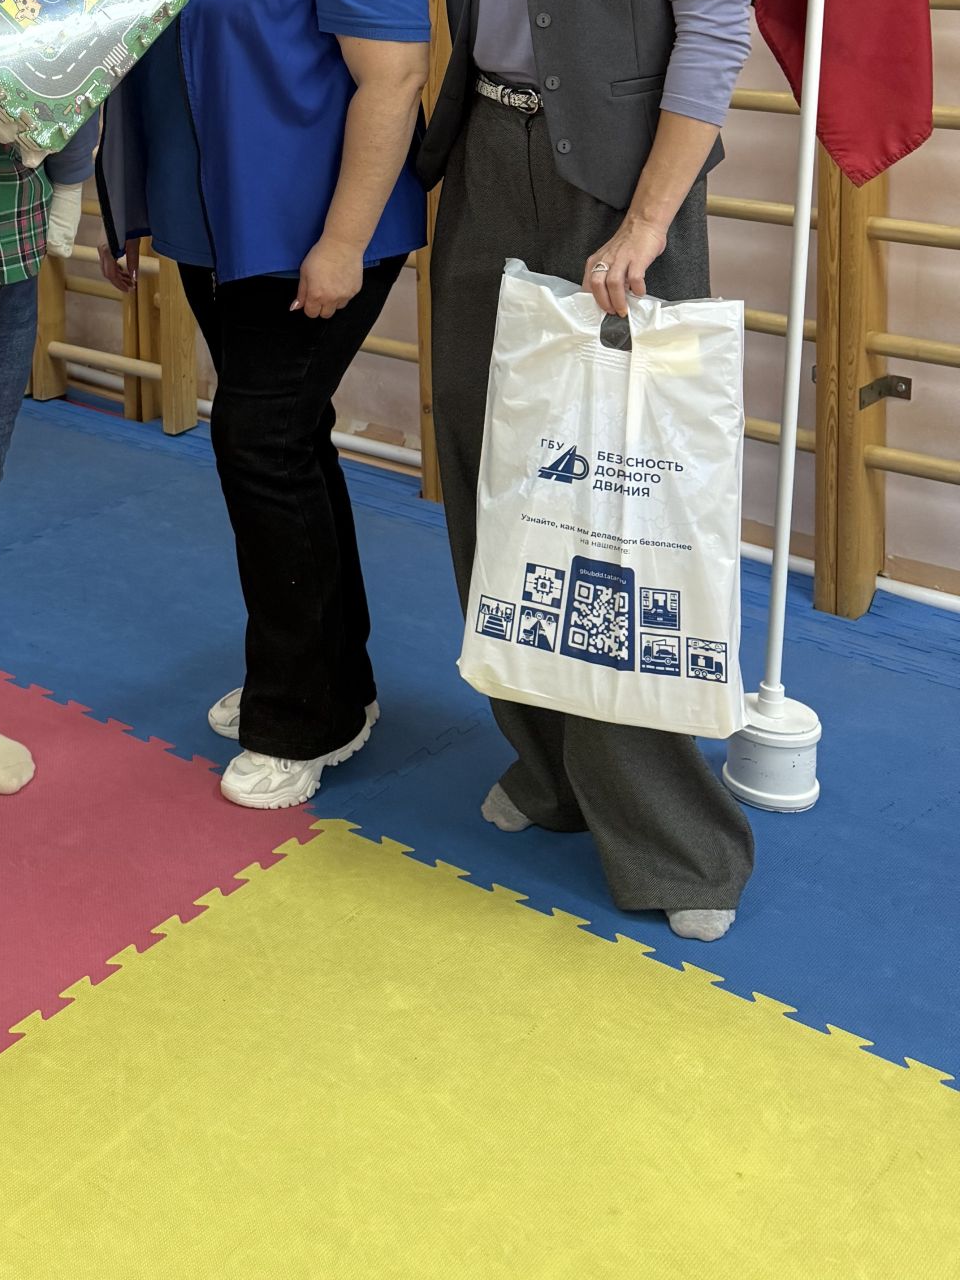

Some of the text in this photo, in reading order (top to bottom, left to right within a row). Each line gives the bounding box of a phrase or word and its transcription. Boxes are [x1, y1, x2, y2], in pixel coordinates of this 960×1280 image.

[540, 438, 565, 451] ГБУ
[597, 451, 684, 472] БЕЗСНОСТЬ
[594, 465, 661, 483] ДОРНОГО
[593, 479, 650, 497] ДВИНИЯ
[520, 513, 558, 528] Узнайте,
[560, 523, 575, 531] как
[577, 527, 589, 535] мы
[640, 538, 692, 551] безопаснее
